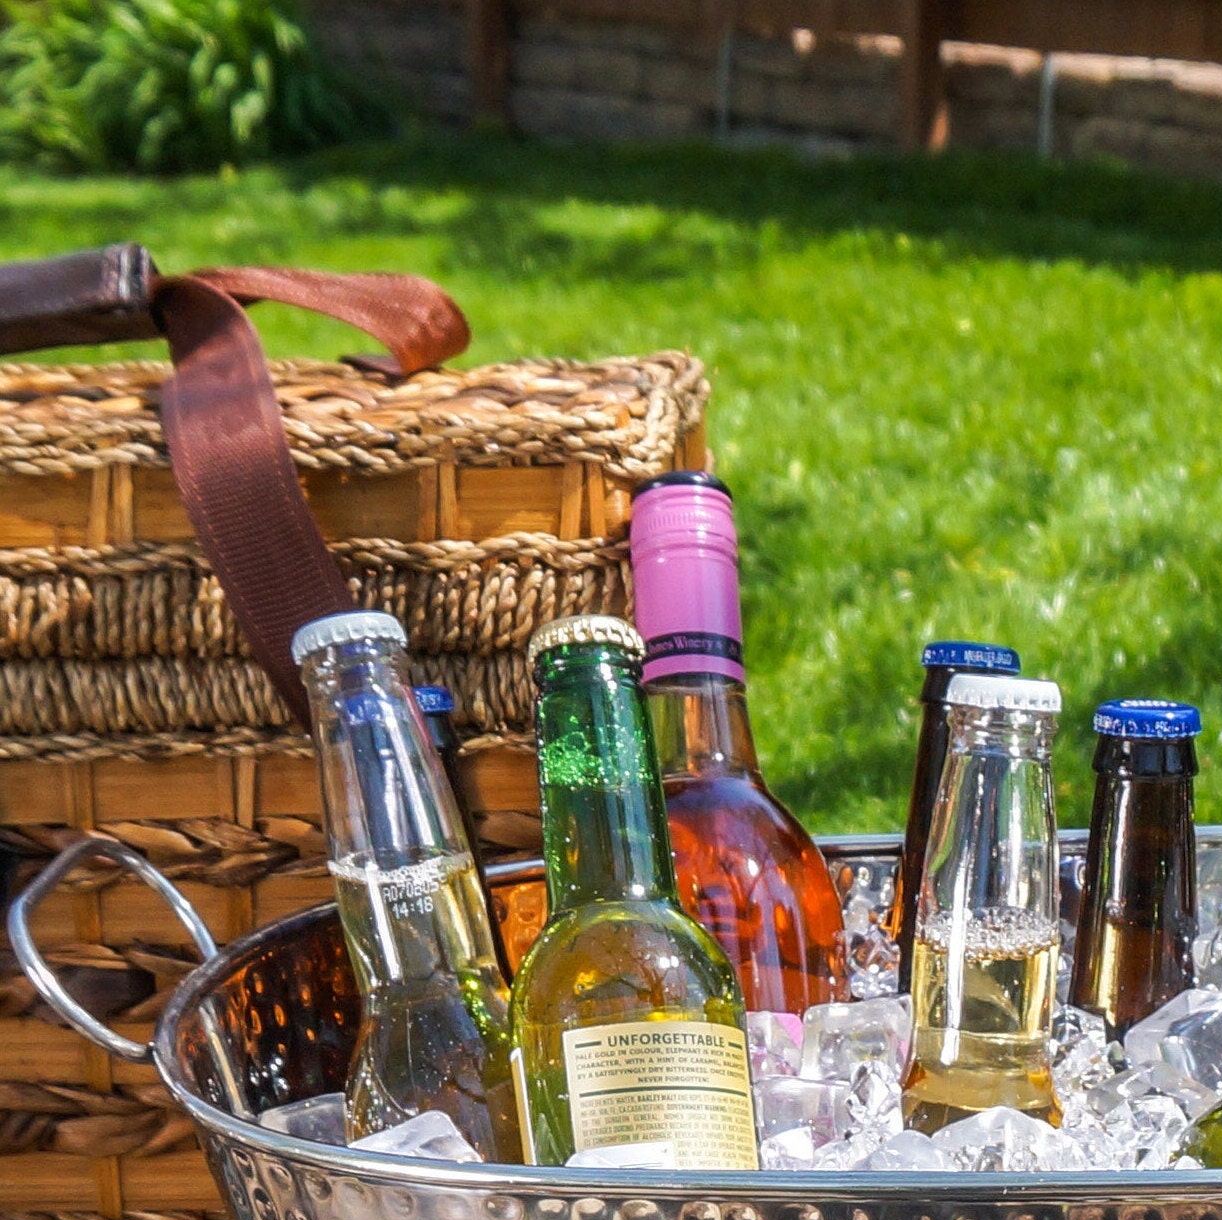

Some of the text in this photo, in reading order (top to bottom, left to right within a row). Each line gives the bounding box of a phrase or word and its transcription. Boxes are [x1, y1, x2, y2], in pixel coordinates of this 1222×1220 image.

[673, 635, 713, 651] Winery
[607, 1033, 725, 1048] UNFORGETTABLE
[595, 1050, 616, 1058] GOLD
[618, 1048, 627, 1056] IN
[629, 1047, 664, 1055] COLOUR,
[666, 1047, 701, 1055] ELEPHANT
[576, 1060, 622, 1070] CHARACTER,
[625, 1057, 645, 1065] WITH
[595, 1067, 646, 1077] SATISFYINGLY
